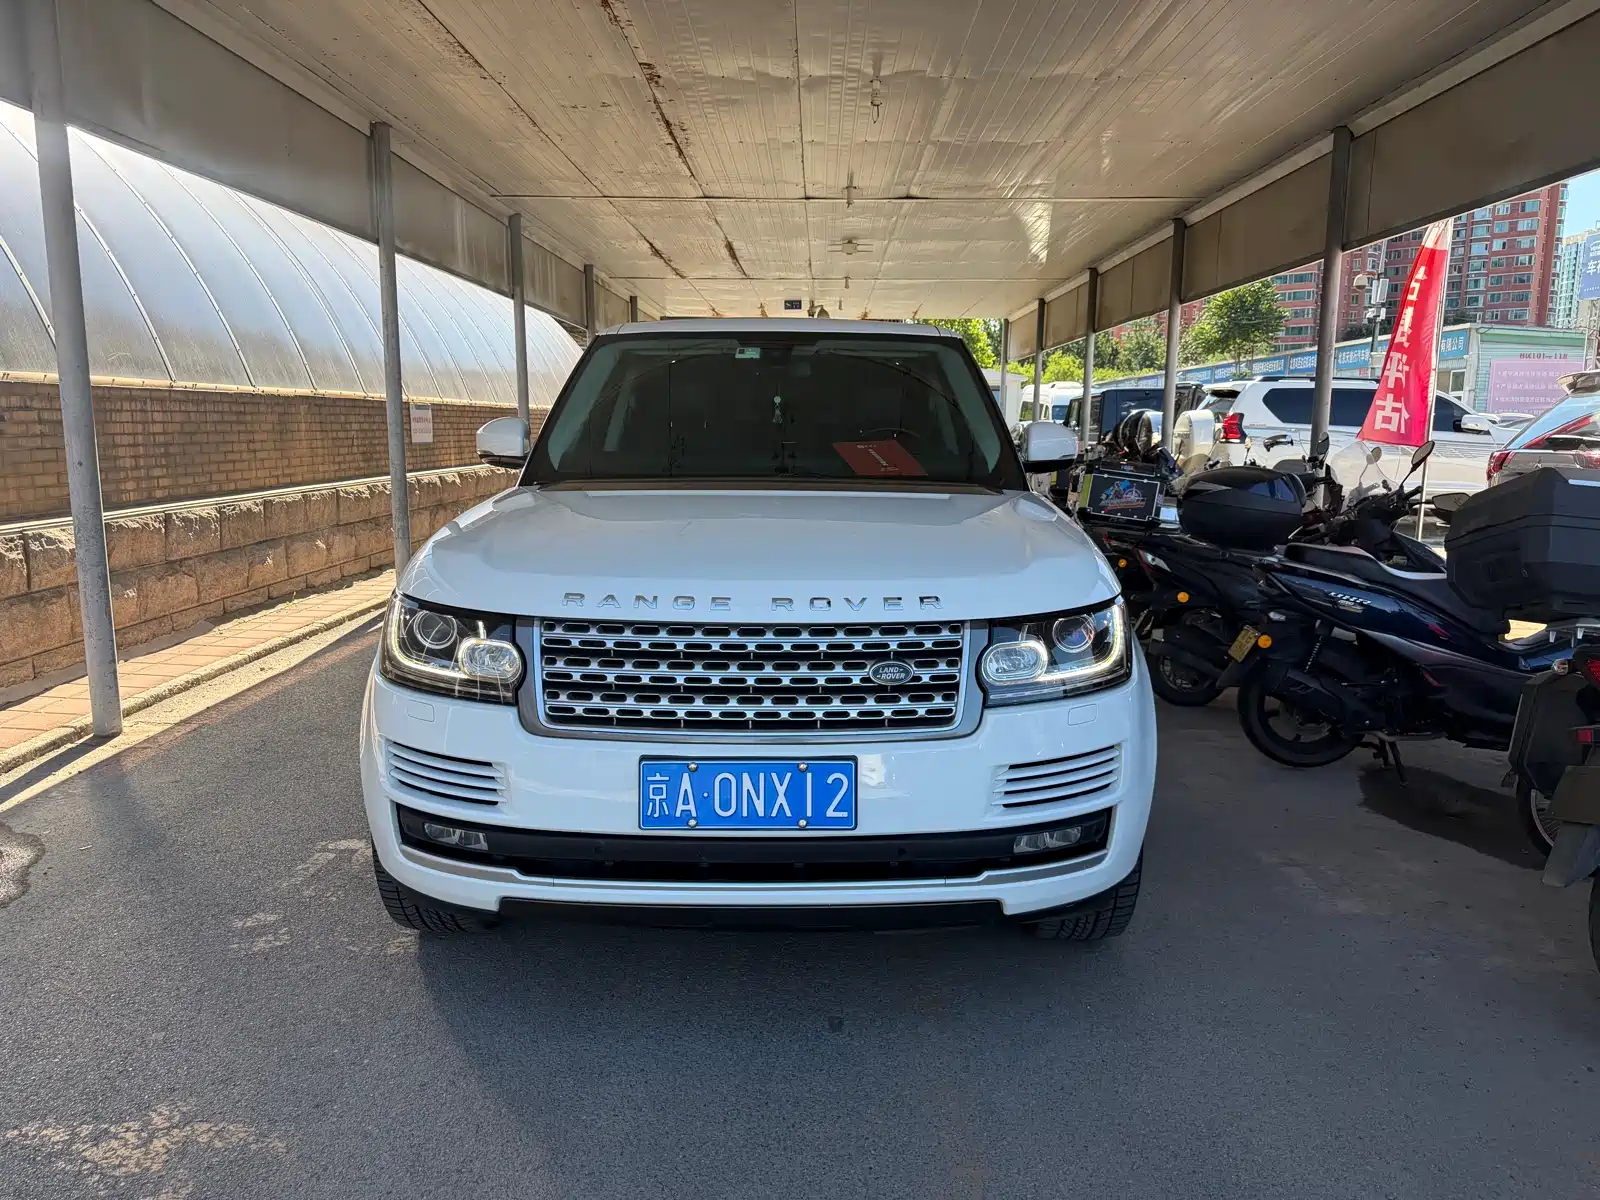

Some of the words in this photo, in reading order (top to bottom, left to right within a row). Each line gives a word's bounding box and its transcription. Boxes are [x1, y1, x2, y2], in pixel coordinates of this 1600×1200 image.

[561, 592, 732, 611] RANGE
[770, 595, 944, 611] ROVER
[881, 672, 906, 680] ROVER
